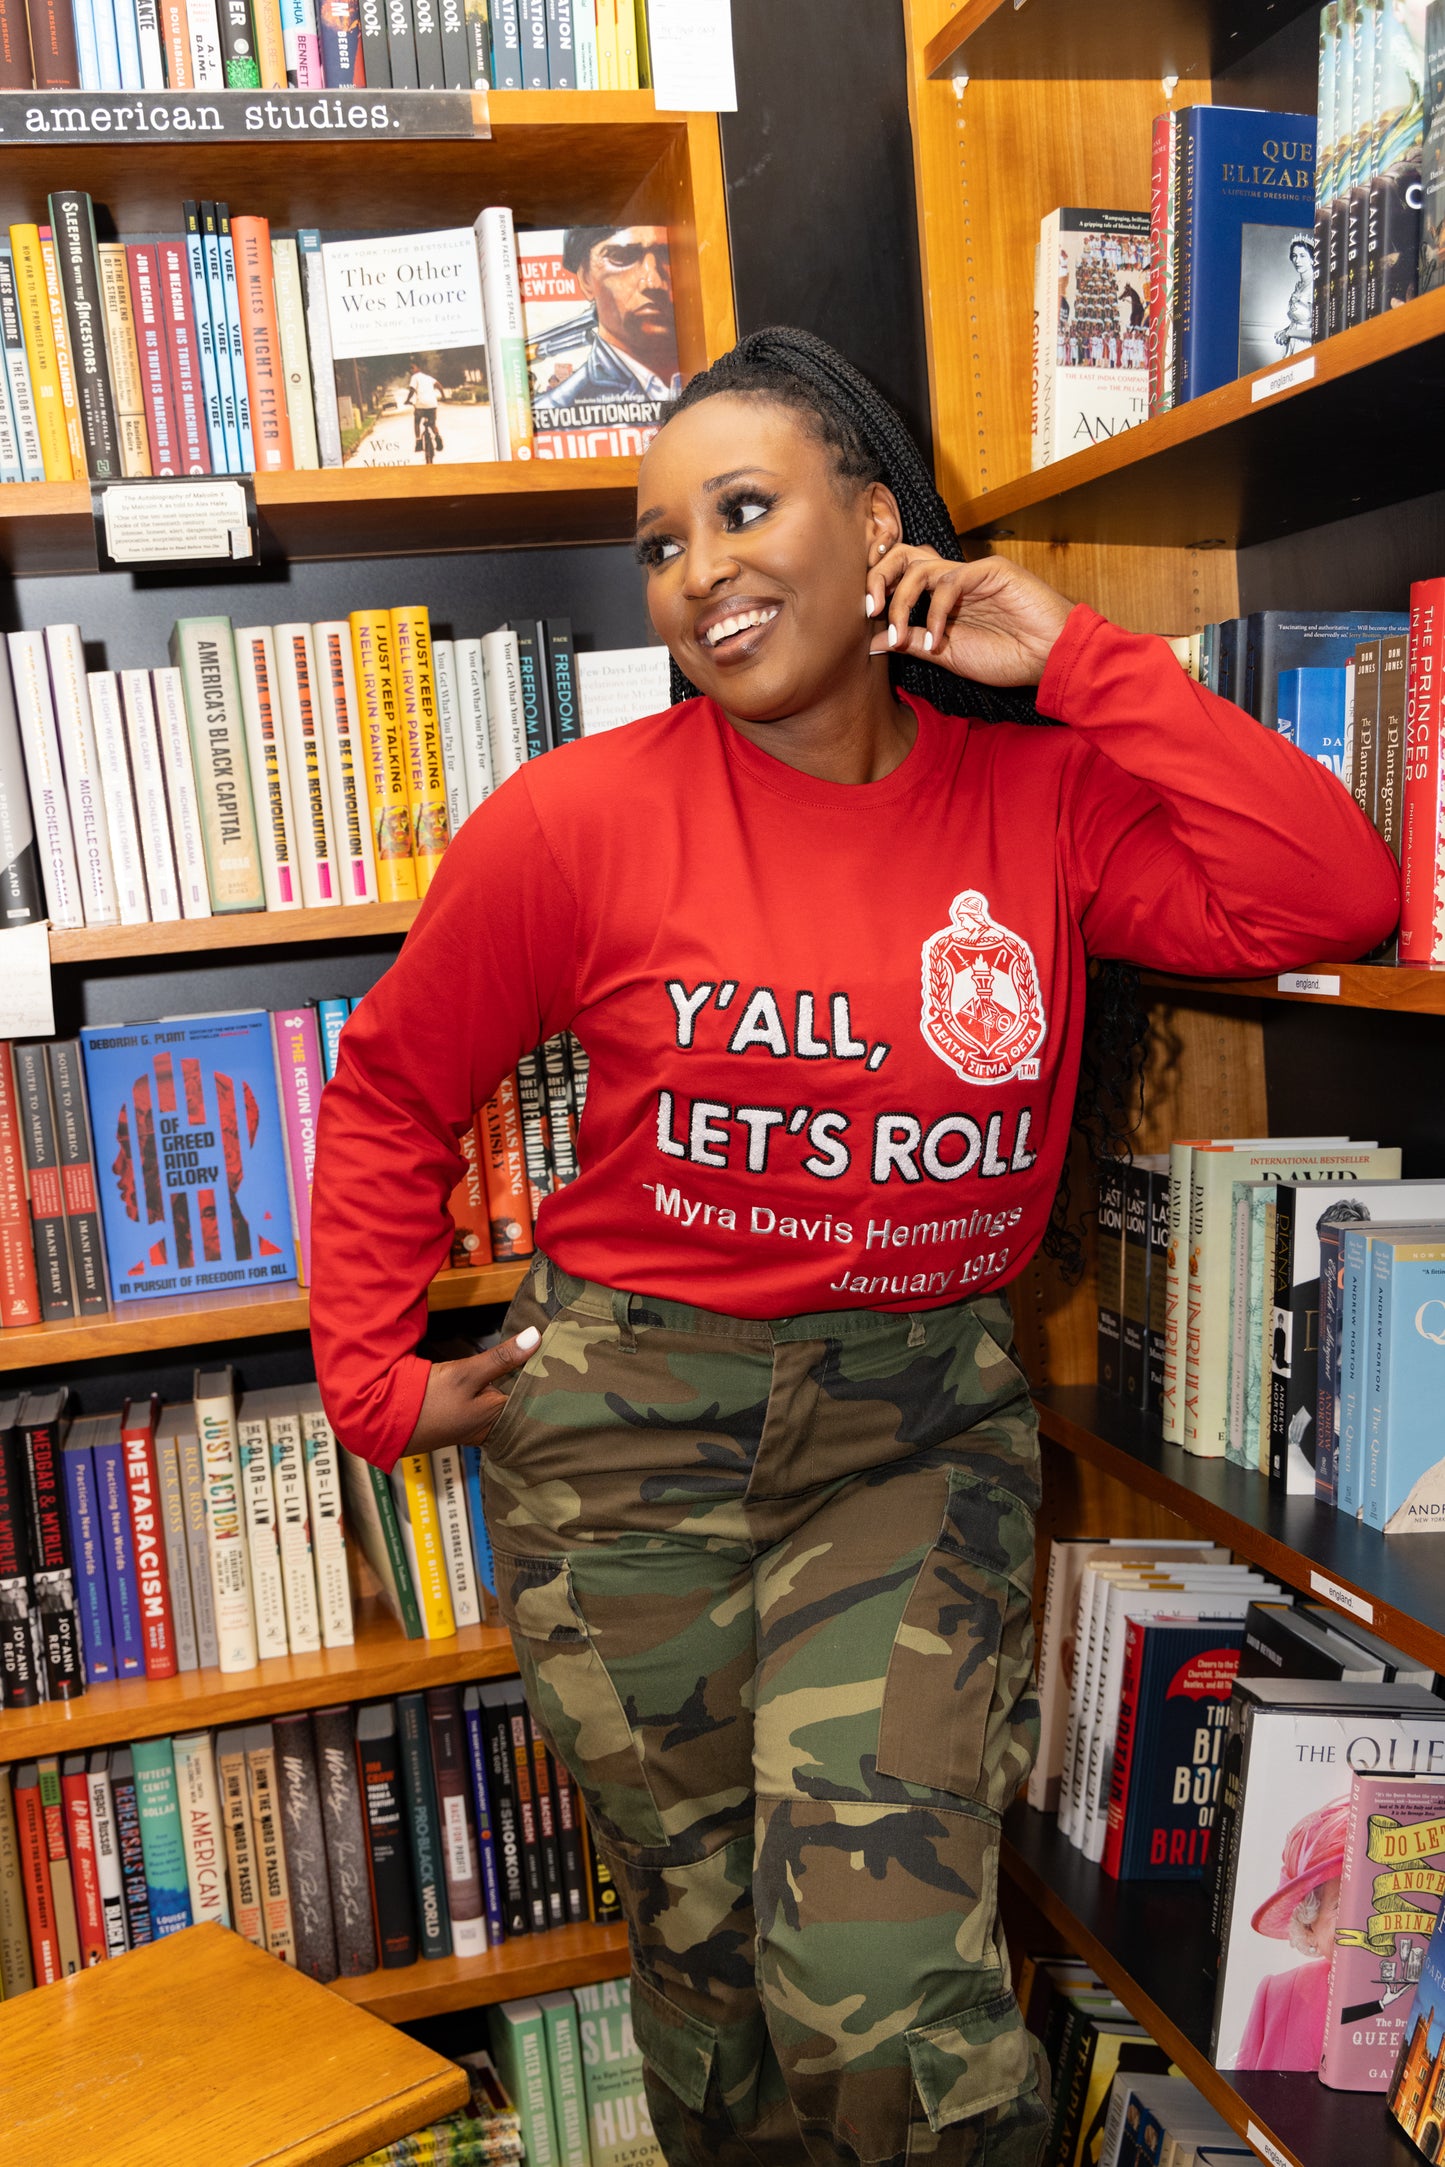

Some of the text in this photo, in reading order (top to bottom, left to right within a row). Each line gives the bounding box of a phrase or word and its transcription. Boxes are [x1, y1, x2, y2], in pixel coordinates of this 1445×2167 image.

[170, 7, 185, 88] BOLU BABALOLA
[195, 35, 207, 81] BAIME
[298, 35, 309, 87] BENNETT
[337, 31, 350, 69] BERGER
[474, 23, 485, 71] ZARIA WARE
[25, 99, 400, 132] american studies.
[499, 214, 507, 242] BROWN
[192, 247, 202, 280] VIBE
[209, 247, 219, 280] VIBE
[224, 249, 234, 281] VIBE
[340, 260, 462, 288] The Other
[502, 245, 510, 268] FACES
[520, 262, 566, 279] UEY P.
[62, 202, 97, 374] SLEEPING WITH THE ANCESTORS
[342, 287, 467, 313] Wes Moore
[523, 279, 576, 298] EWTON
[1149, 167, 1161, 406] TANGLED SOULS
[42, 248, 74, 408] LIFTING AS THEY CLIMBED
[508, 301, 516, 330] SPACES
[245, 237, 279, 439] TIYA MILES NIGHT FLYER
[136, 253, 170, 463] JON MEACHAM HIS TRUTH IS MARCHING ON
[1030, 310, 1040, 436] AGINCOURT
[1269, 371, 1295, 391] england.
[533, 401, 661, 428] REVOLUTIONARY
[138, 494, 183, 502] Autobiography
[378, 636, 390, 673] JUST
[1358, 662, 1376, 676] JONES
[1361, 651, 1374, 662] DAN
[360, 627, 385, 795] NELL IRVIN PAINTER
[381, 678, 395, 720] KEEP
[441, 688, 449, 713] What
[554, 653, 574, 733] FREEDOM
[1405, 607, 1421, 781] IN THE TOWER
[1415, 605, 1435, 780] THE PRINCES
[198, 640, 241, 845] AMERICA'S BLACK CAPITAL
[443, 715, 451, 735] You
[252, 639, 288, 862] IJEOMA OLUO BE A REVOLUTION
[386, 728, 402, 793] TALKING
[445, 736, 453, 754] Pay
[447, 755, 455, 772] For
[1381, 715, 1399, 843] The Plantagenets
[1295, 977, 1320, 991] england.
[90, 1037, 138, 1050] DEBORAH
[141, 1035, 151, 1045] G.
[155, 1031, 186, 1044] PLANT
[665, 980, 891, 1071] Y'ALL,
[1020, 1063, 1036, 1077] TM
[160, 1118, 180, 1135] OF
[291, 1034, 316, 1180] THE KEVIN POWELL
[162, 1131, 215, 1152] GREED
[503, 1109, 523, 1196] WAS KING
[522, 1102, 546, 1177] REMINDING
[657, 1090, 1037, 1185] LET'S ROLL
[165, 1151, 200, 1169] AND
[166, 1166, 219, 1188] GLORY
[1250, 1156, 1370, 1166] INTERNATIONAL BESTSELLER
[750, 1207, 854, 1243] Davis
[866, 1204, 1022, 1250] Hemmings
[830, 1247, 1009, 1295] January 1913
[1276, 1213, 1291, 1294] DIANA
[120, 1263, 287, 1294] IN PURSUIT OF FREEDOM FOR ALL
[1348, 1276, 1358, 1380] ANDREW MORTON
[1272, 1380, 1280, 1432] MORTON
[1277, 1385, 1285, 1434] ANDREW
[203, 1417, 232, 1463] JUST
[248, 1437, 265, 1483] COLOR
[209, 1473, 239, 1540] ACTION
[253, 1500, 270, 1525] LAW
[442, 1458, 467, 1592] HIS NAME IS GEORGE FLOYD
[126, 1439, 164, 1618] METARACISM
[1328, 1587, 1354, 1608] england.
[49, 1634, 59, 1664] REID
[59, 1617, 74, 1673] JOY-ANN
[1295, 1745, 1335, 1763] THE
[137, 1767, 172, 1781] FIFTEEN
[143, 1780, 170, 1793] CENTS
[93, 1783, 112, 1856] Legacy Russell
[142, 1804, 175, 1818] DOLLAR
[539, 1796, 552, 1836] RACISM
[190, 1810, 220, 1909] AMERICAN
[1384, 1833, 1408, 1857] DO
[414, 1806, 440, 1938] PRO-BLACK WORLD
[156, 1912, 186, 1925] LOUISE
